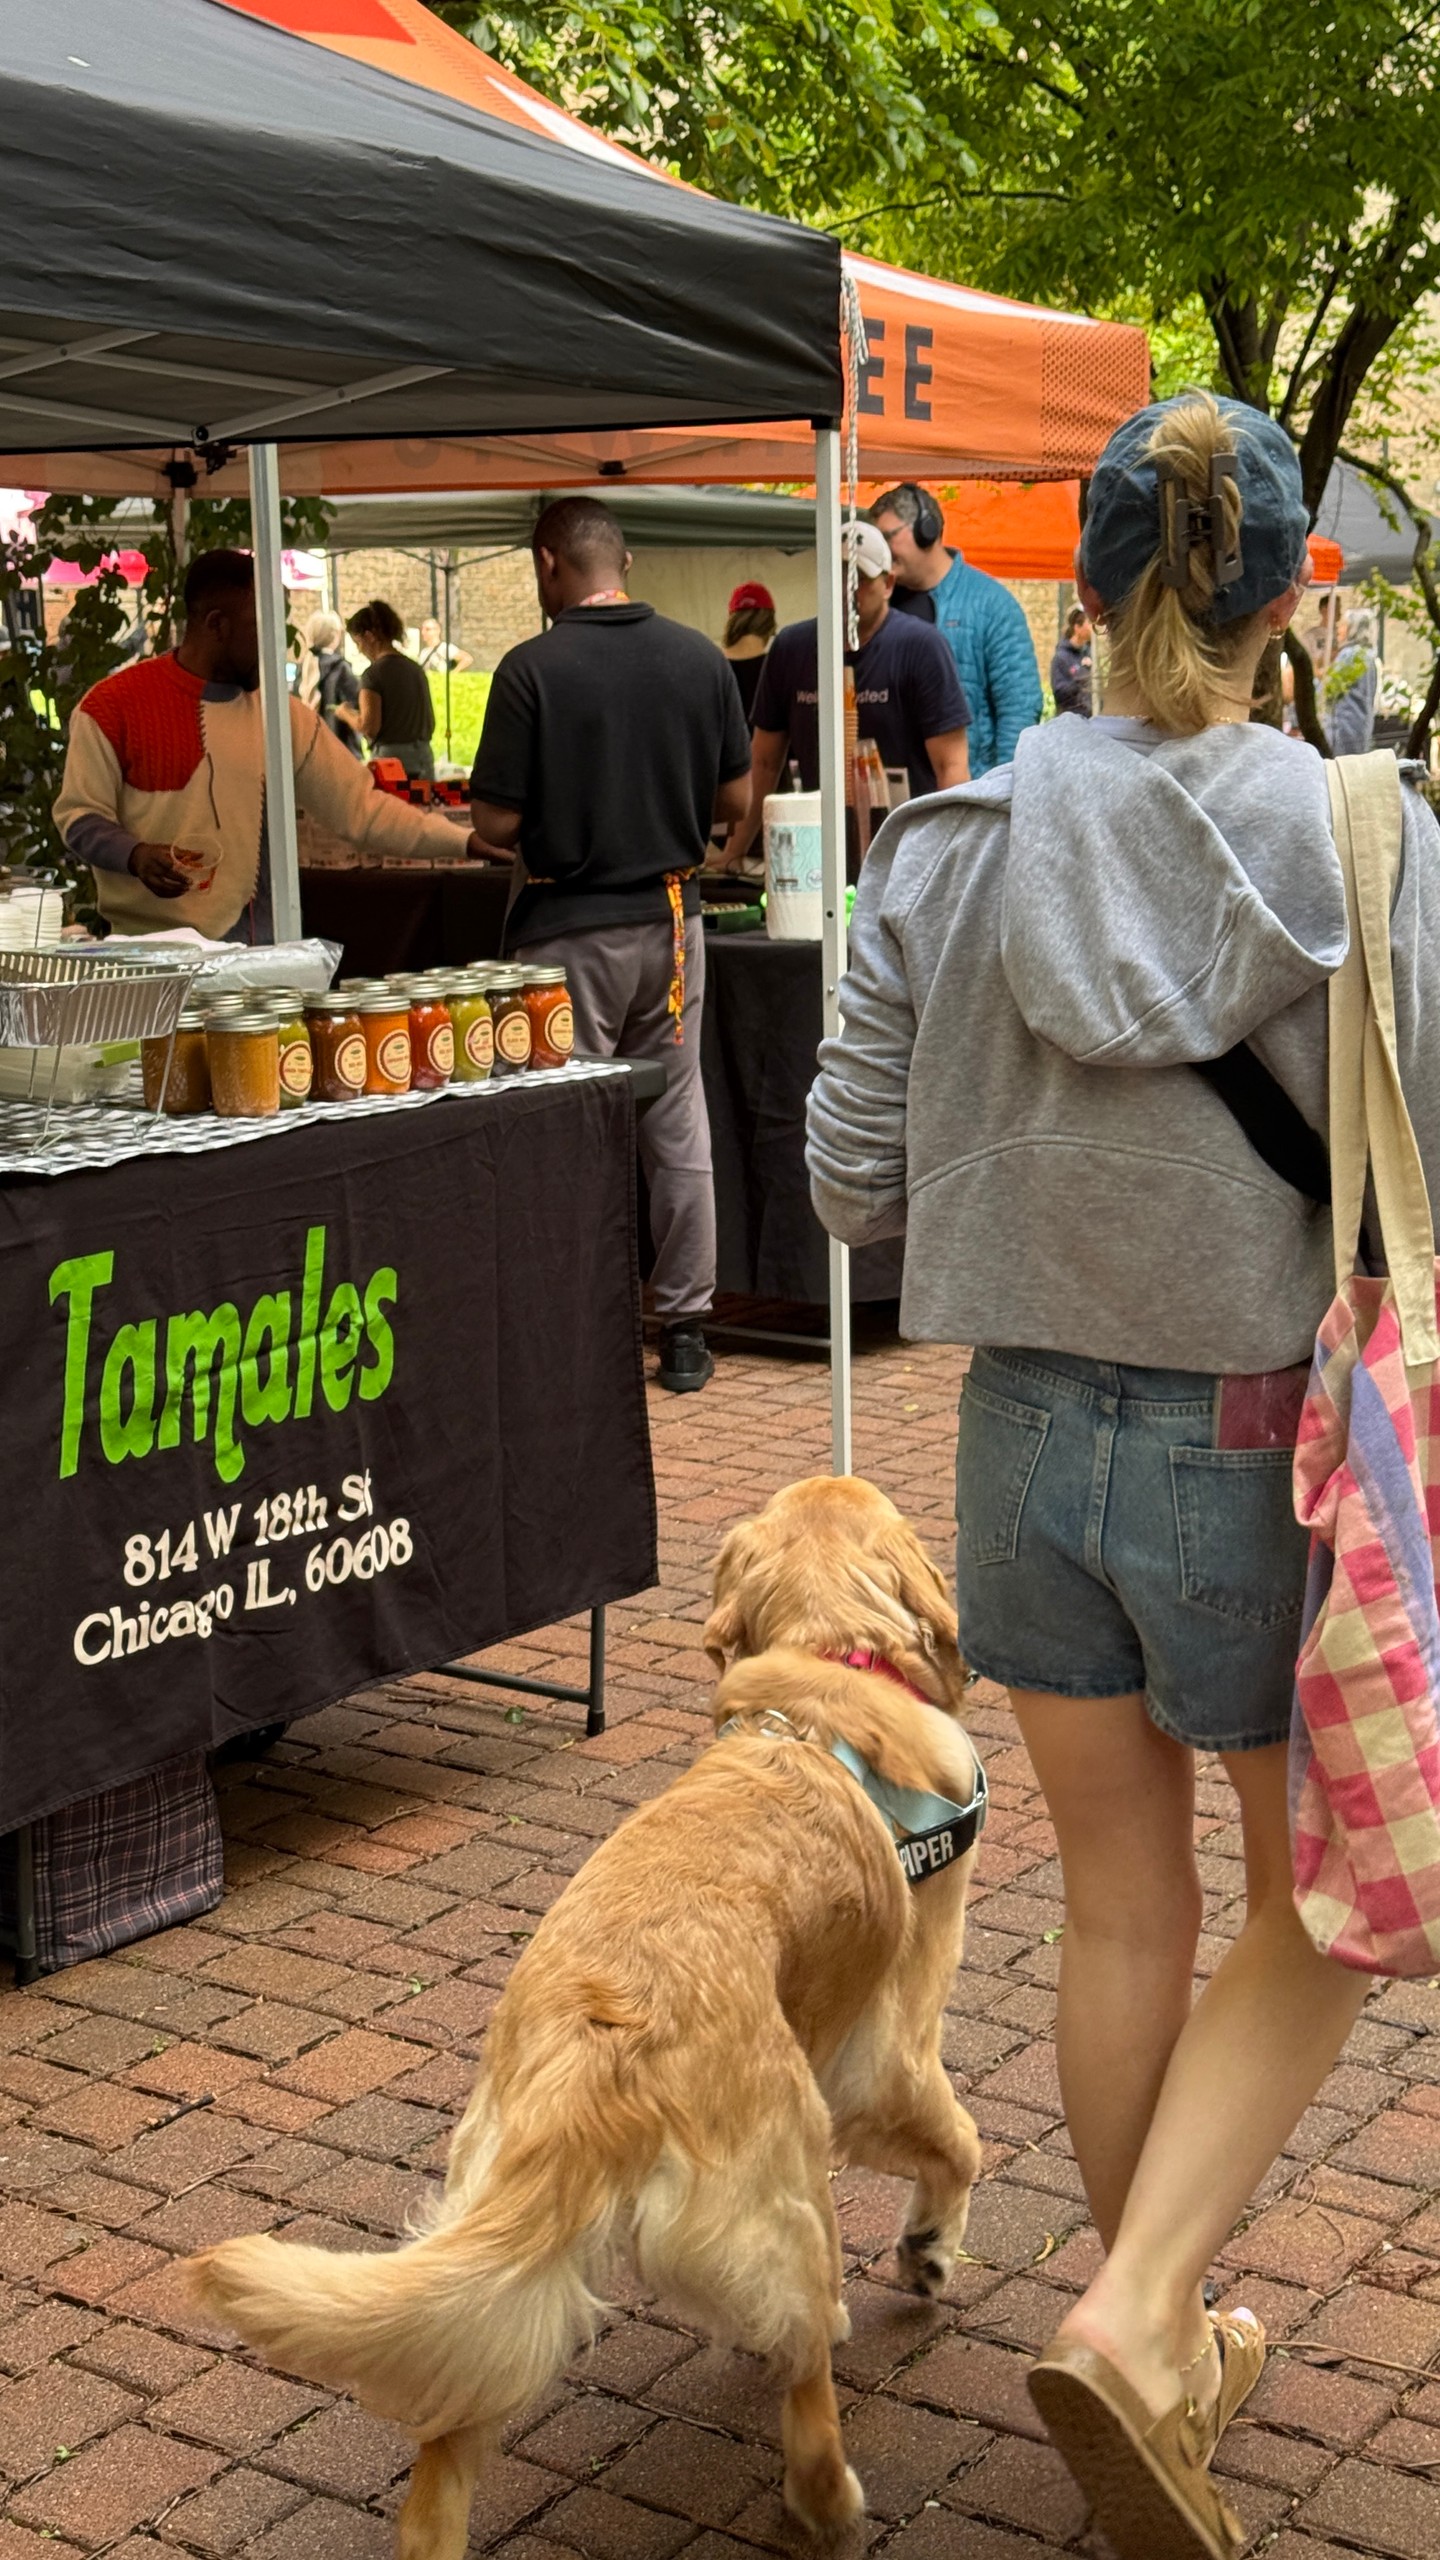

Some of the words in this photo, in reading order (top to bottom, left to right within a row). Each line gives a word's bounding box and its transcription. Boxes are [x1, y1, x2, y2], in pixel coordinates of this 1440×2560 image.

[856, 687, 890, 704] sted
[49, 1226, 397, 1484] Tamales
[73, 1583, 235, 1666] Chicago
[244, 1558, 297, 1610] IL,
[305, 1517, 414, 1592] 60608
[123, 1520, 198, 1587] 814
[203, 1503, 242, 1559] W
[254, 1485, 329, 1547] 18th
[337, 1468, 374, 1522] St
